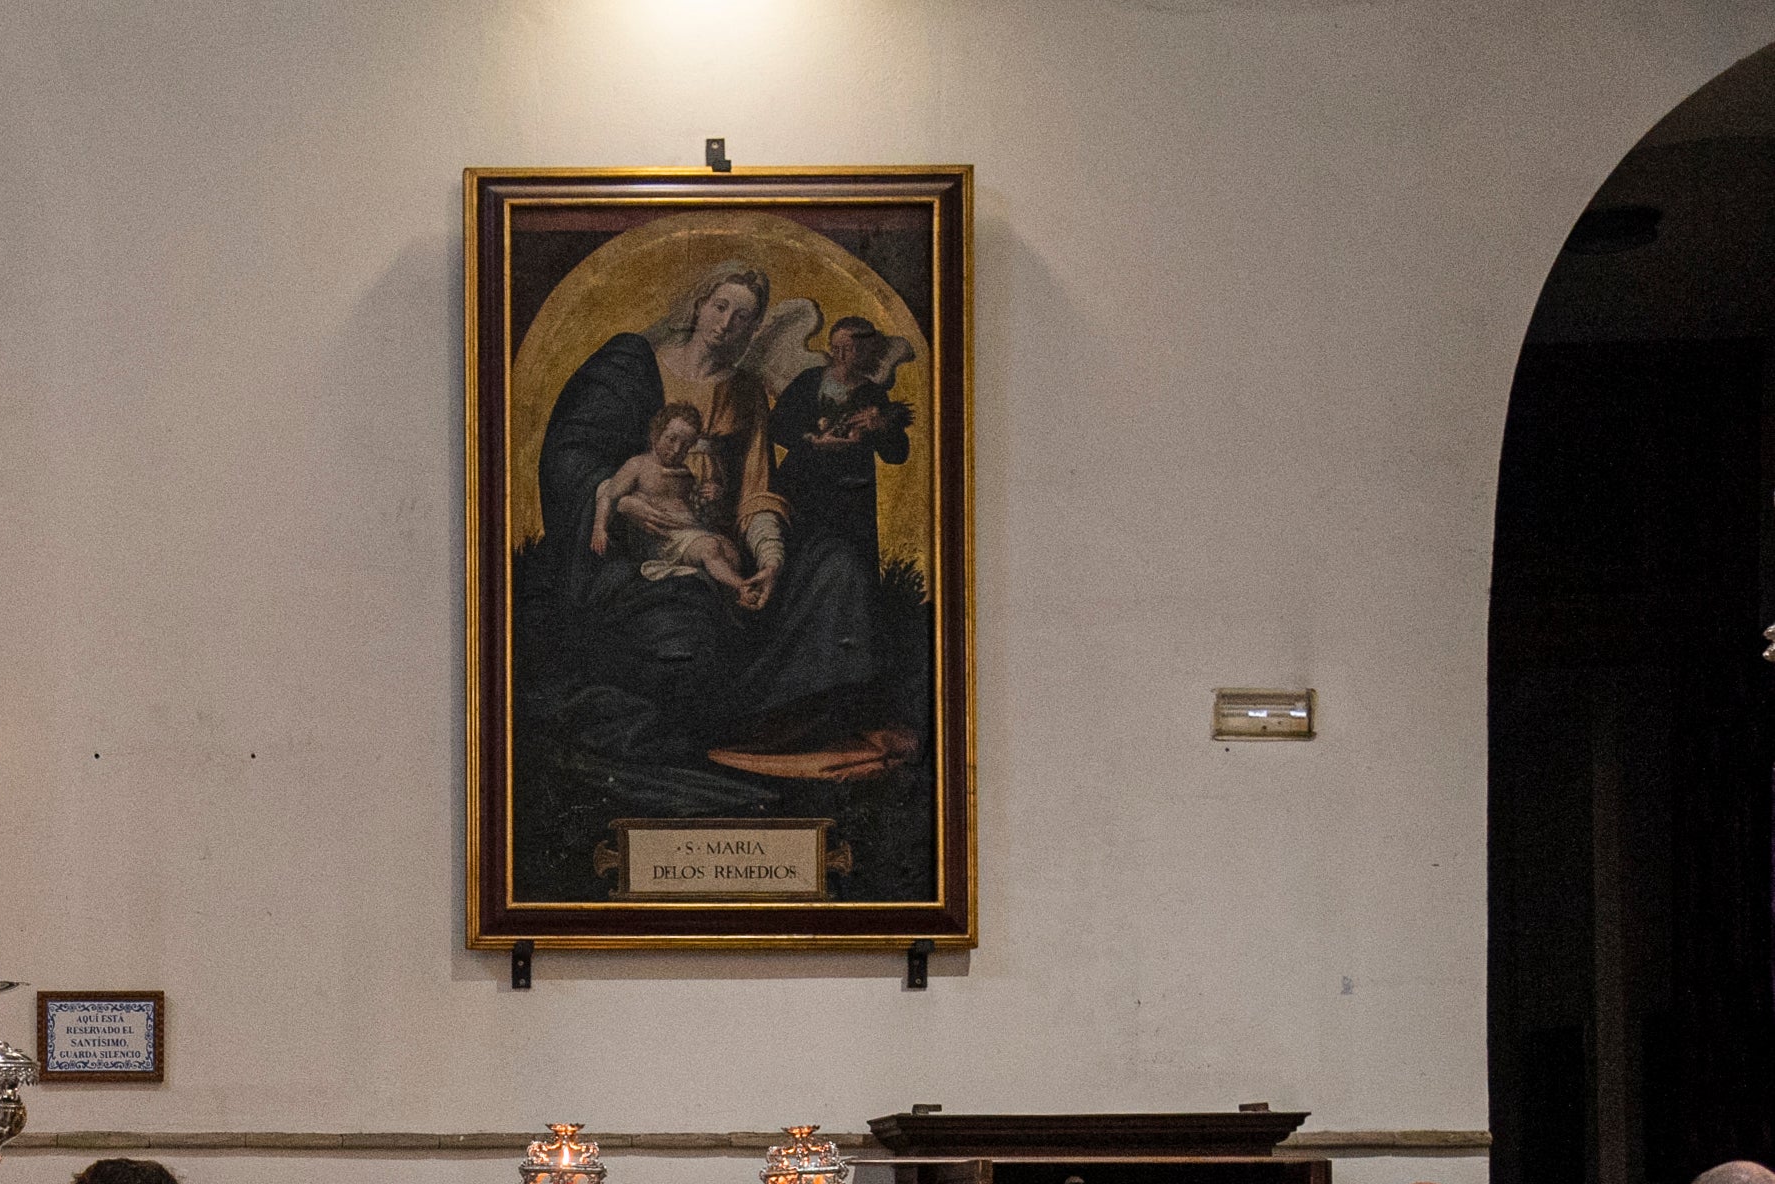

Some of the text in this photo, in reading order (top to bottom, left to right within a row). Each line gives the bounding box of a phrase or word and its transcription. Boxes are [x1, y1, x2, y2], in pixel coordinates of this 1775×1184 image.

[706, 841, 766, 855] MARIA
[714, 865, 798, 880] REMEDIOS
[76, 1013, 125, 1024] AQUÍ ESTÁ
[66, 1026, 135, 1035] RESERVADO EL
[59, 1050, 141, 1059] GUARDA SILENCIO
